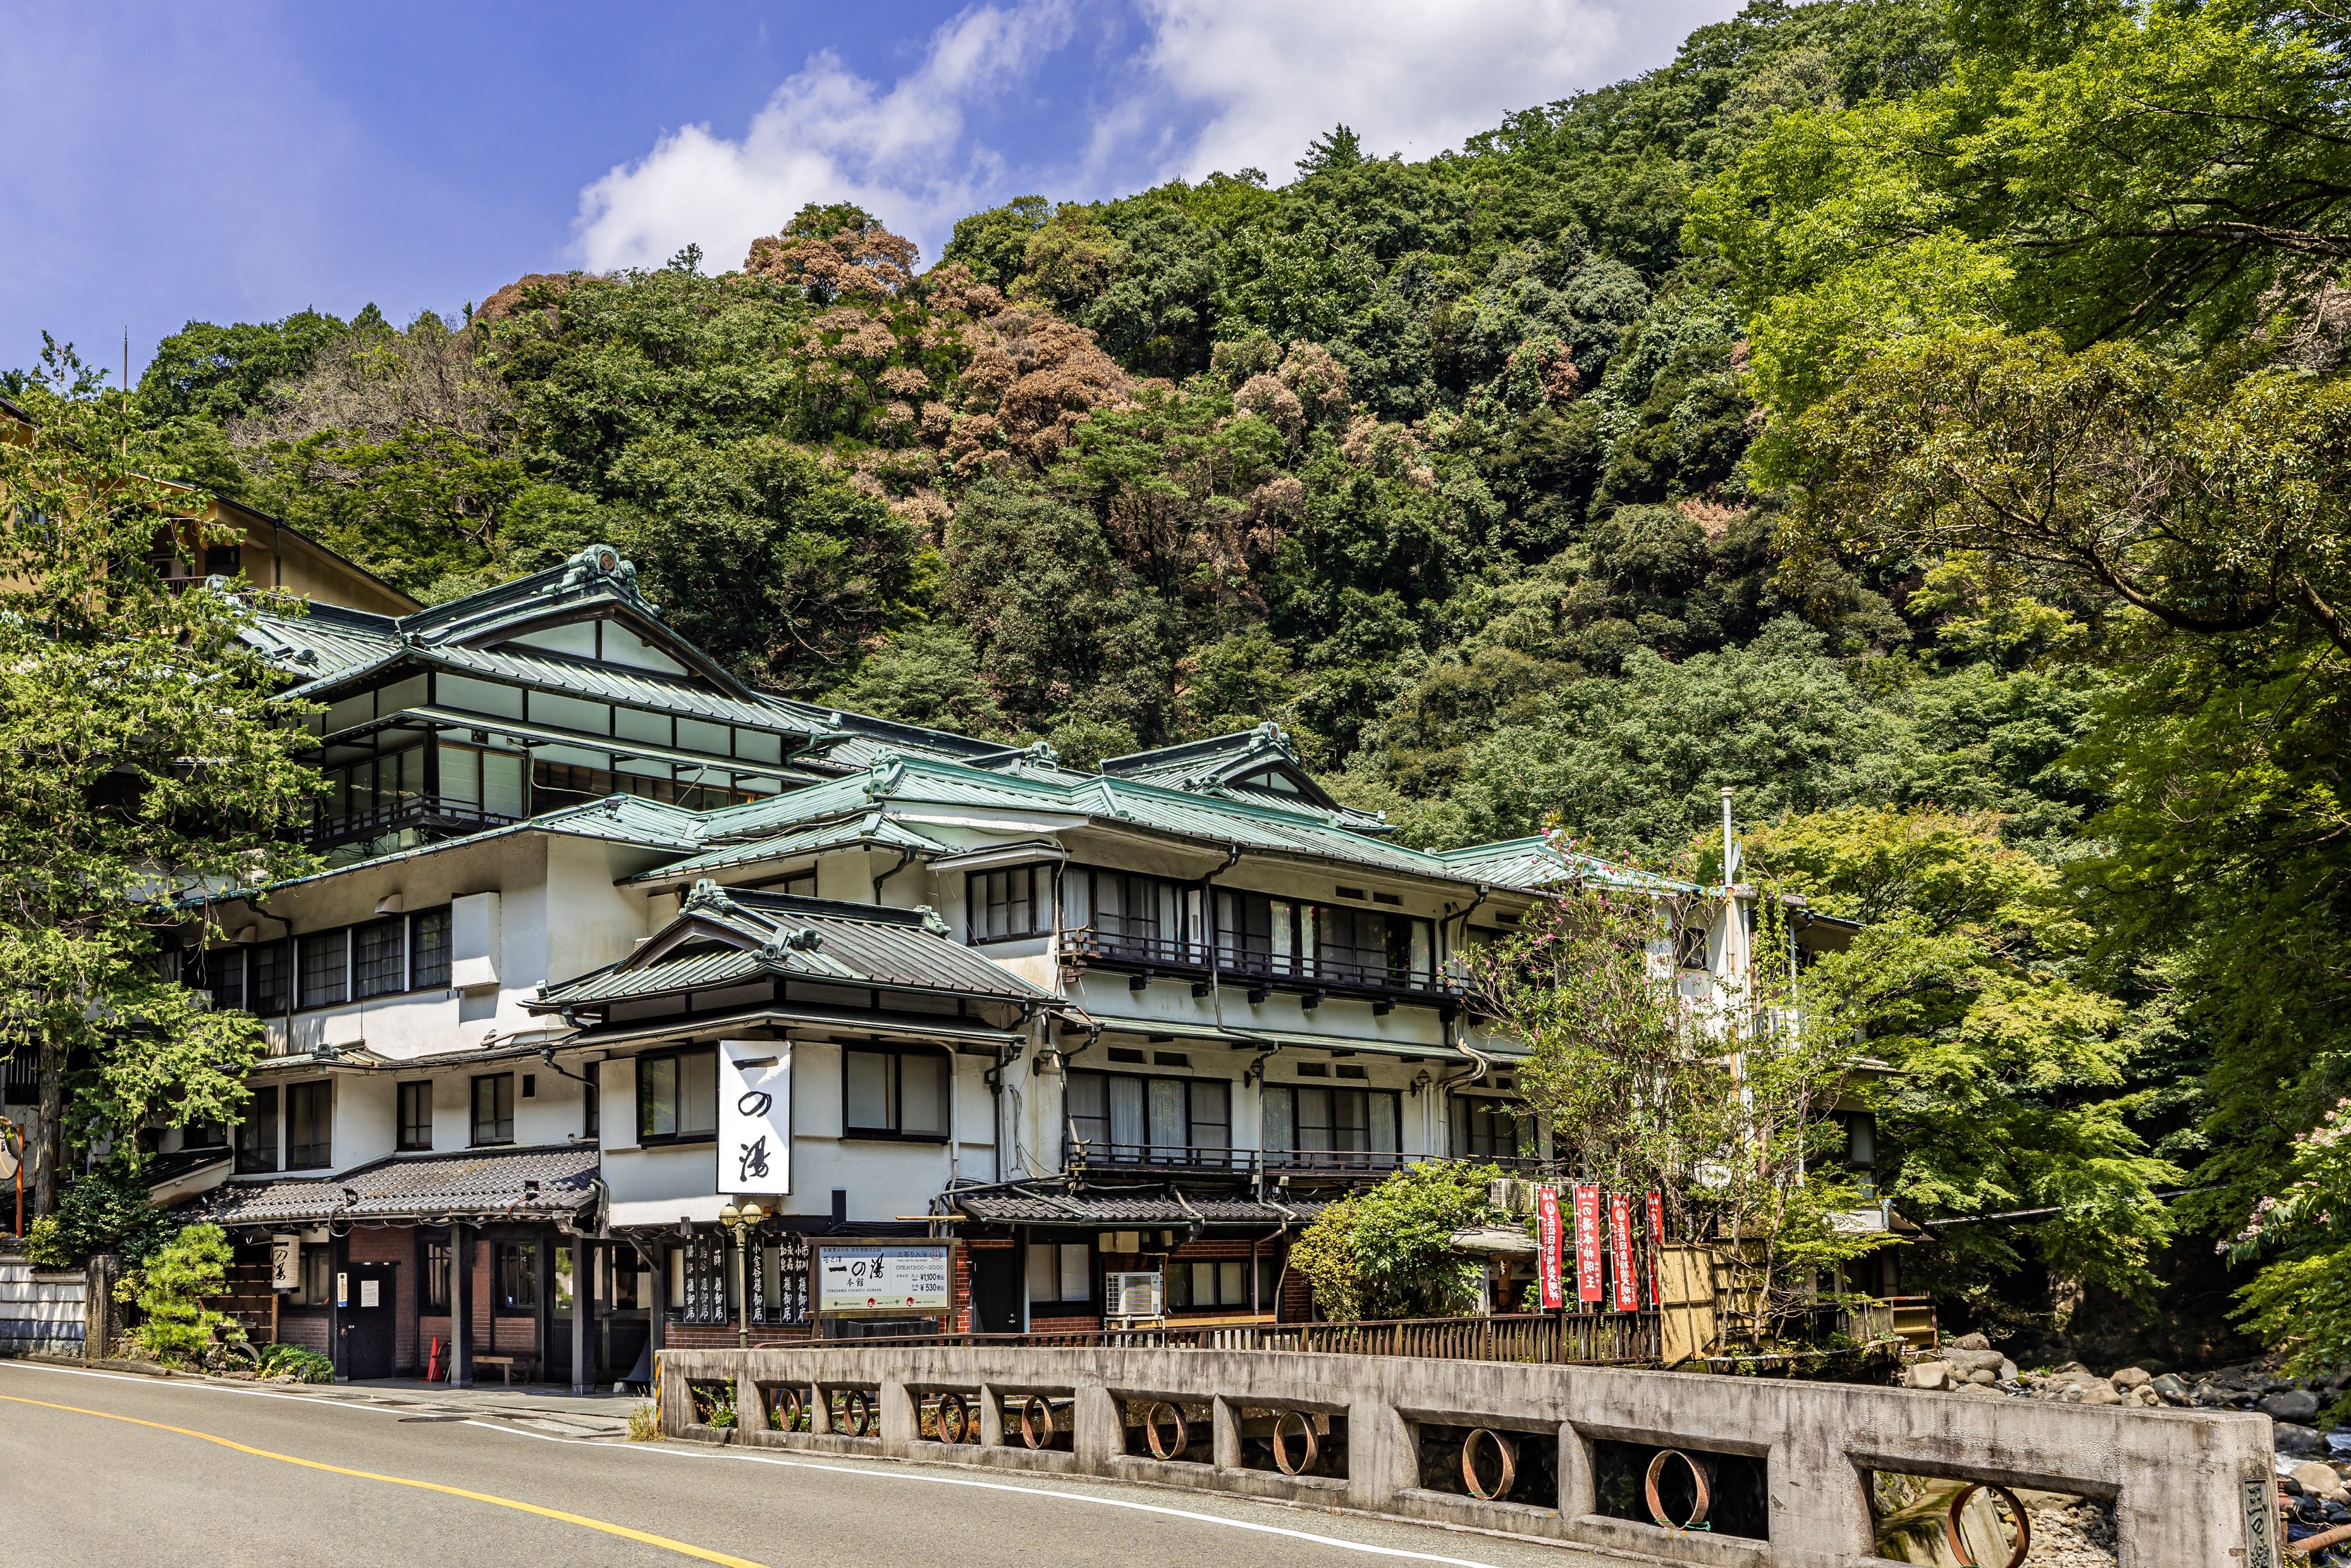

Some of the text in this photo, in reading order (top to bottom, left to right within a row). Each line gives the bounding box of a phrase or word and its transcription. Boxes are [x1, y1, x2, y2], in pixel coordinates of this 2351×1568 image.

[732, 1056, 779, 1182] 一の湯
[273, 1242, 289, 1281] 一の湯
[828, 1253, 884, 1279] 一の湯
[752, 1242, 763, 1321] 小金谷様御席
[846, 1277, 864, 1287] 本館
